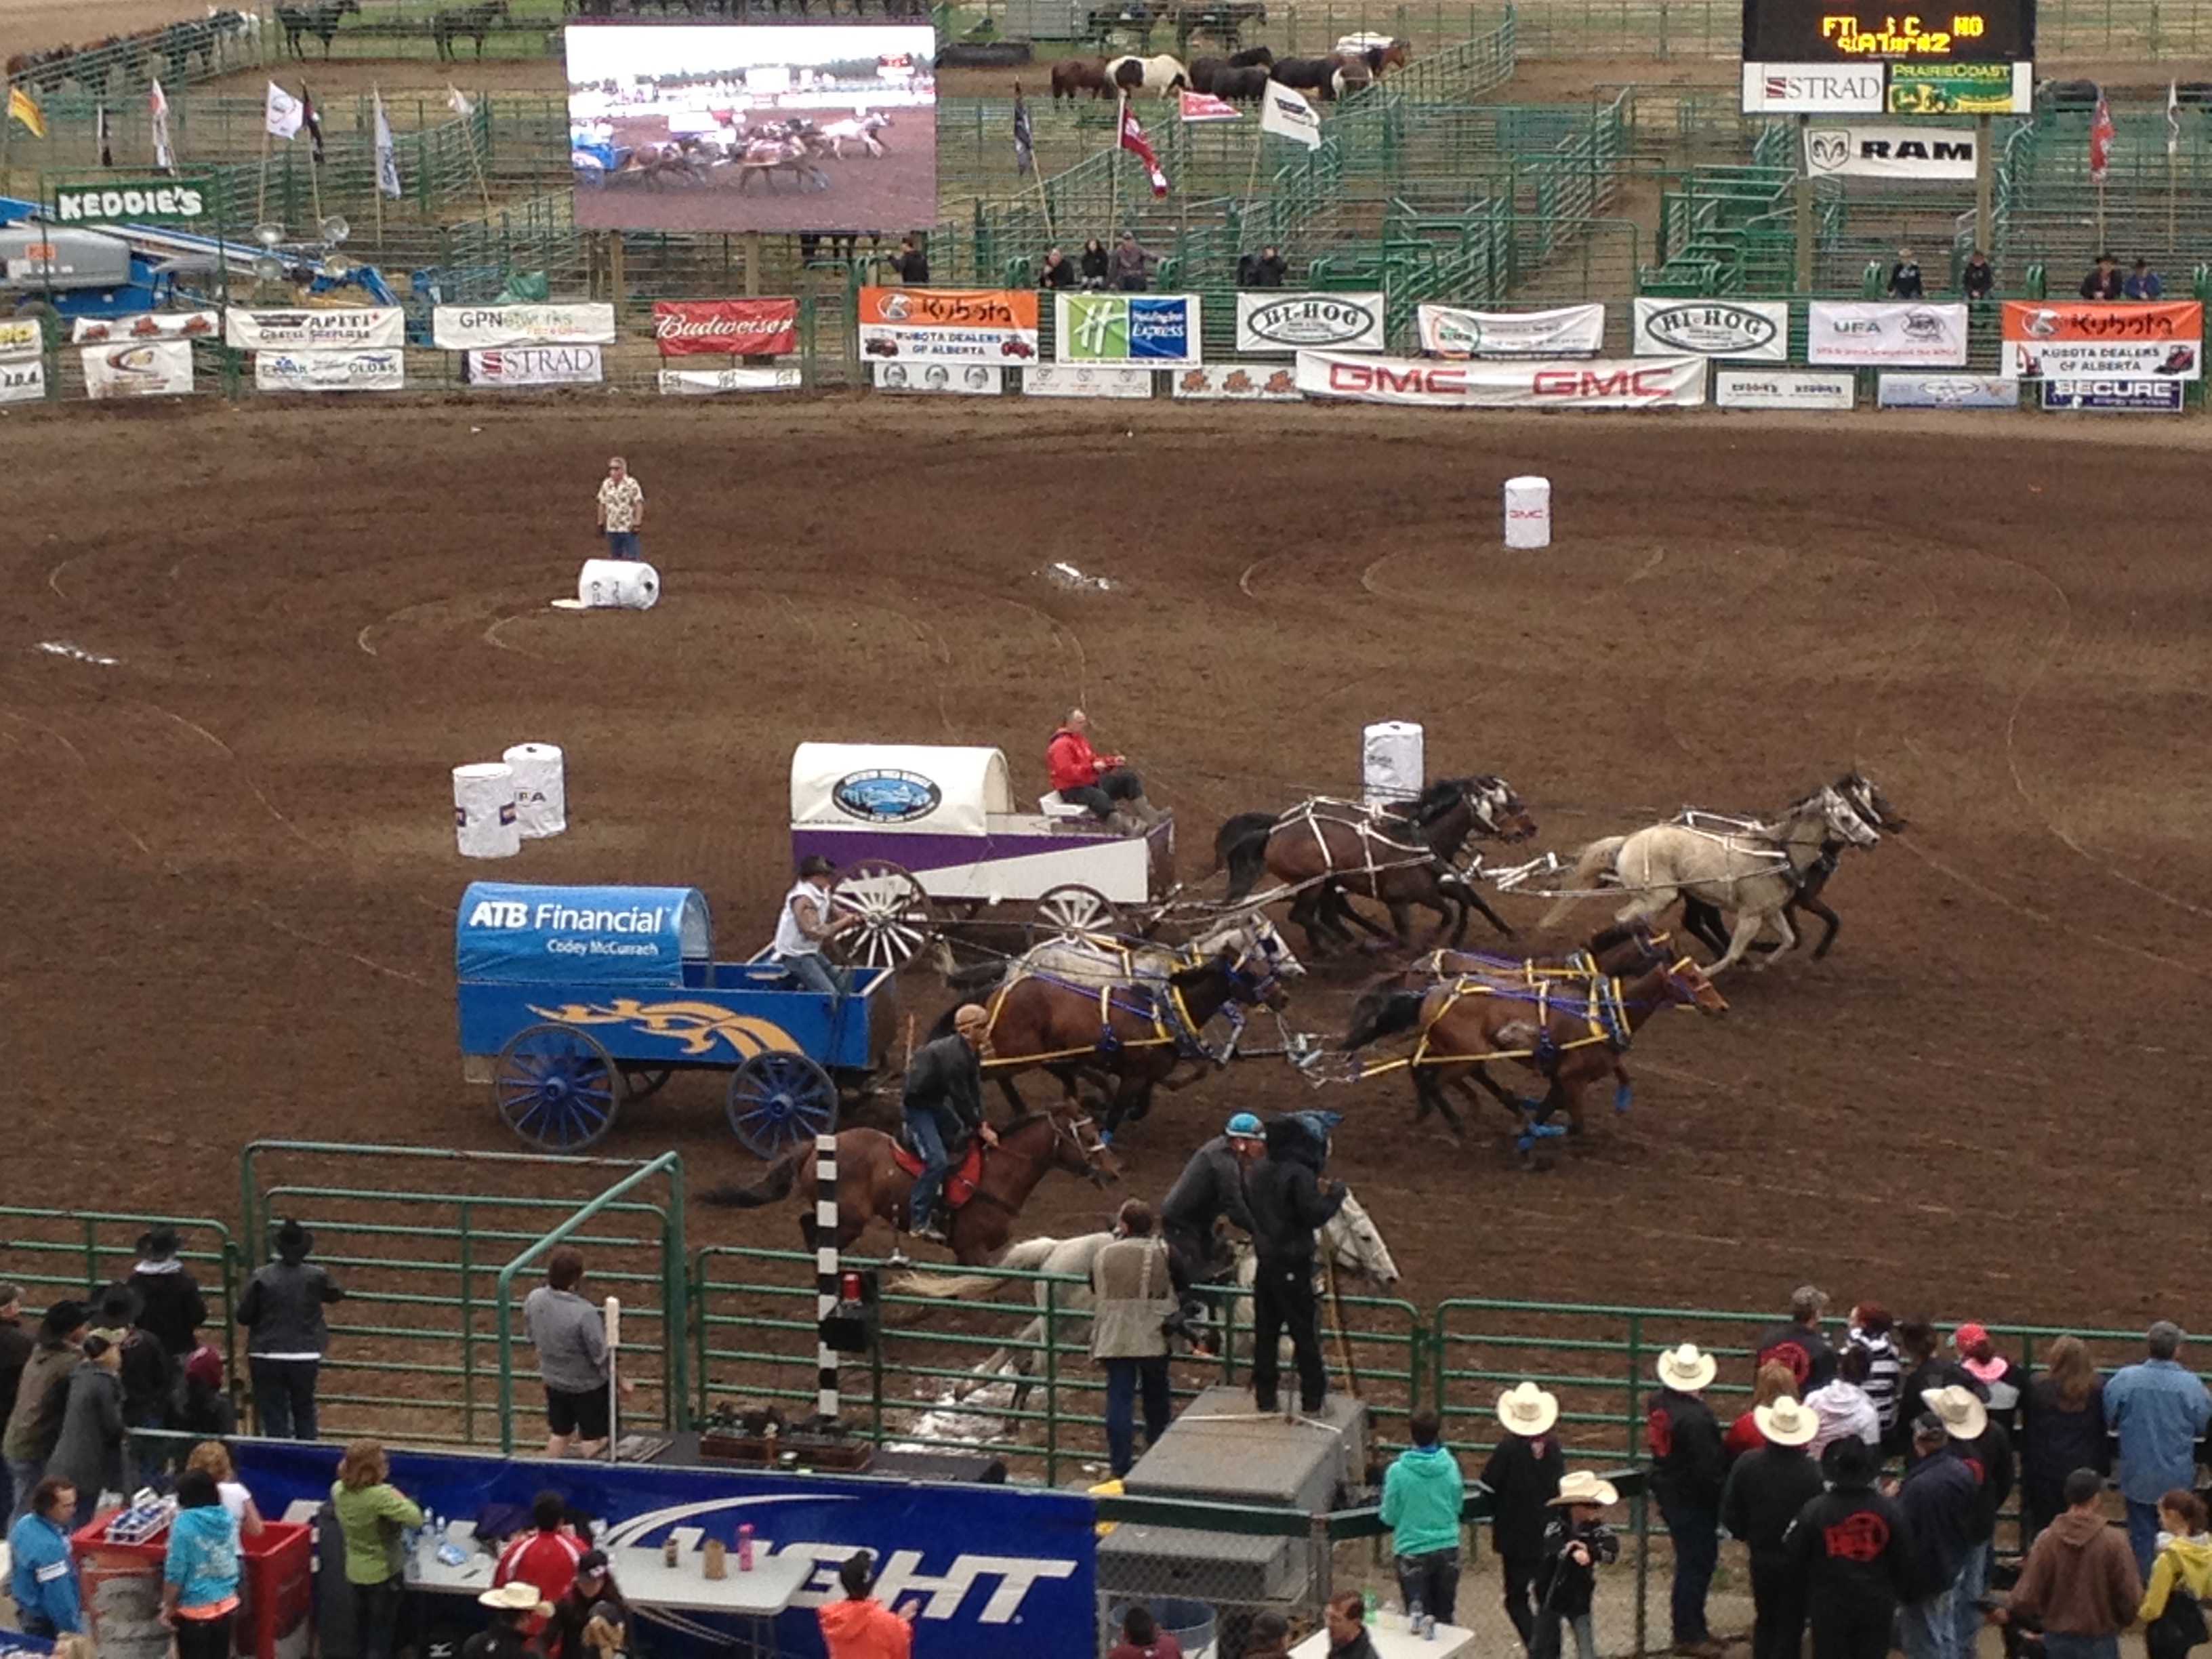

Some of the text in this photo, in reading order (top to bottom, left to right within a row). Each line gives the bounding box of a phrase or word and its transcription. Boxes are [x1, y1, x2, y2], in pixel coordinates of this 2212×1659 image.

[1787, 77, 1881, 100] STRAD
[1860, 140, 1973, 161] RAM
[58, 185, 203, 220] KEDDIE'S
[922, 298, 1012, 323] Kubota
[1263, 302, 1359, 327] HI-HOG
[654, 313, 794, 338] Budweiser
[1833, 321, 1881, 334] UFA
[2071, 312, 2173, 335] Kubota
[503, 348, 594, 373] STRAD
[931, 346, 986, 355] ALBERTA
[2041, 348, 2160, 358] KUBOTA DEALERS
[2081, 361, 2142, 371] ALBERTA
[1329, 362, 1674, 396] GMC GMC
[469, 901, 663, 934] ATB Financial
